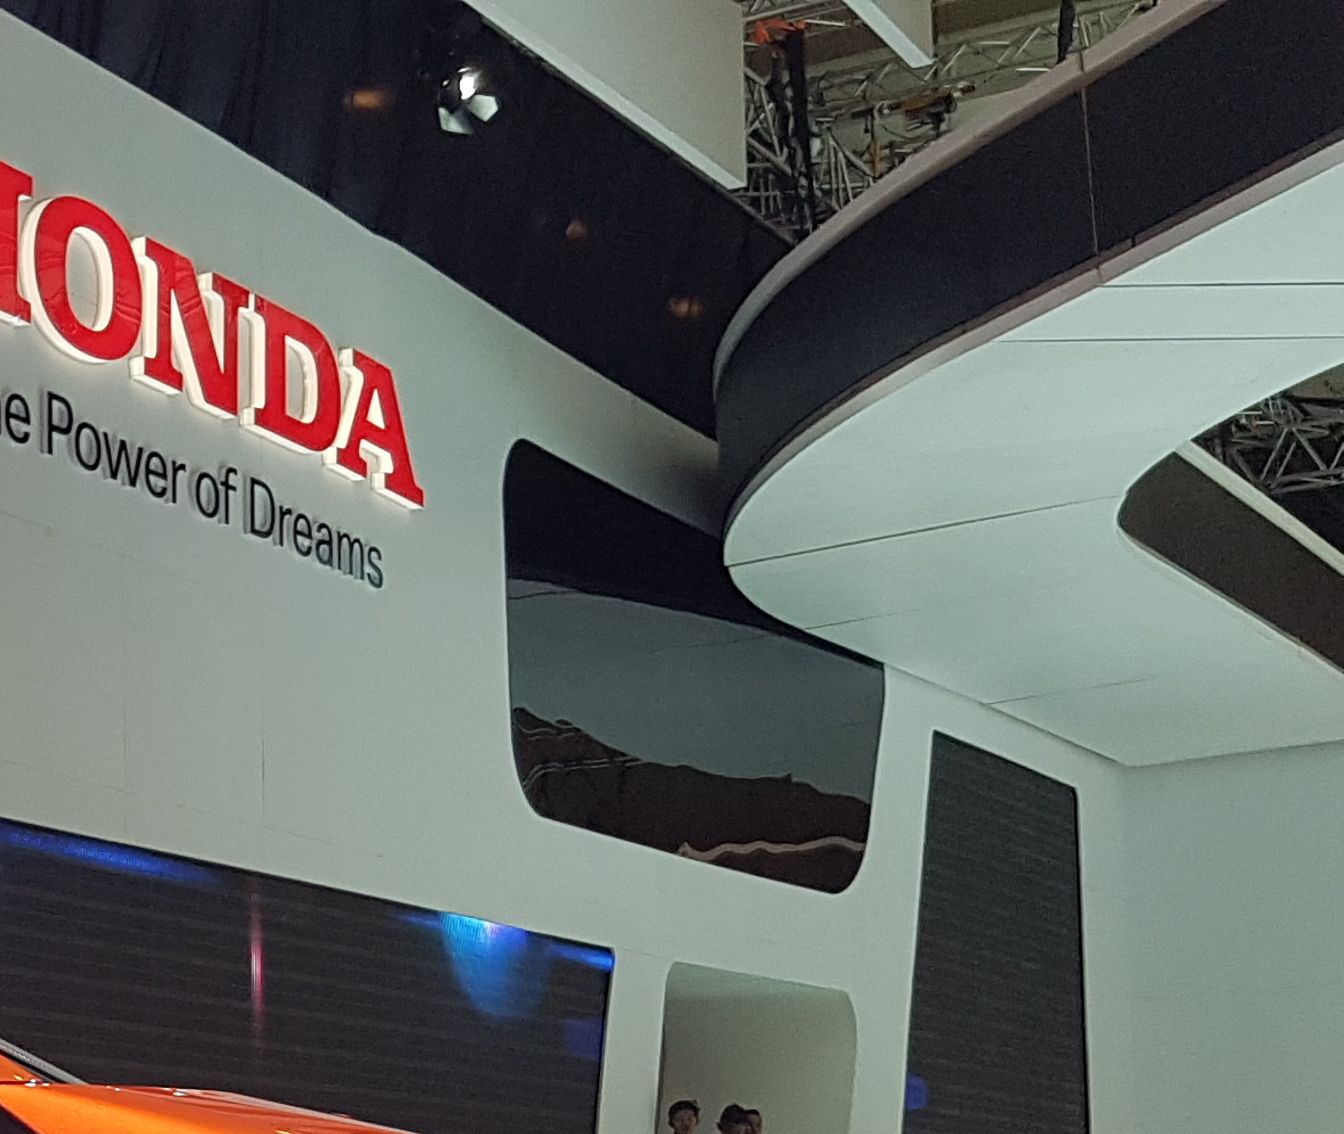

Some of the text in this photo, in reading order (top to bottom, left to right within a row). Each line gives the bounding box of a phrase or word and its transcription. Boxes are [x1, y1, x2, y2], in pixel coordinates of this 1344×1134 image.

[45, 390, 187, 504] Power
[195, 466, 238, 525] of
[249, 476, 384, 589] Dreams
